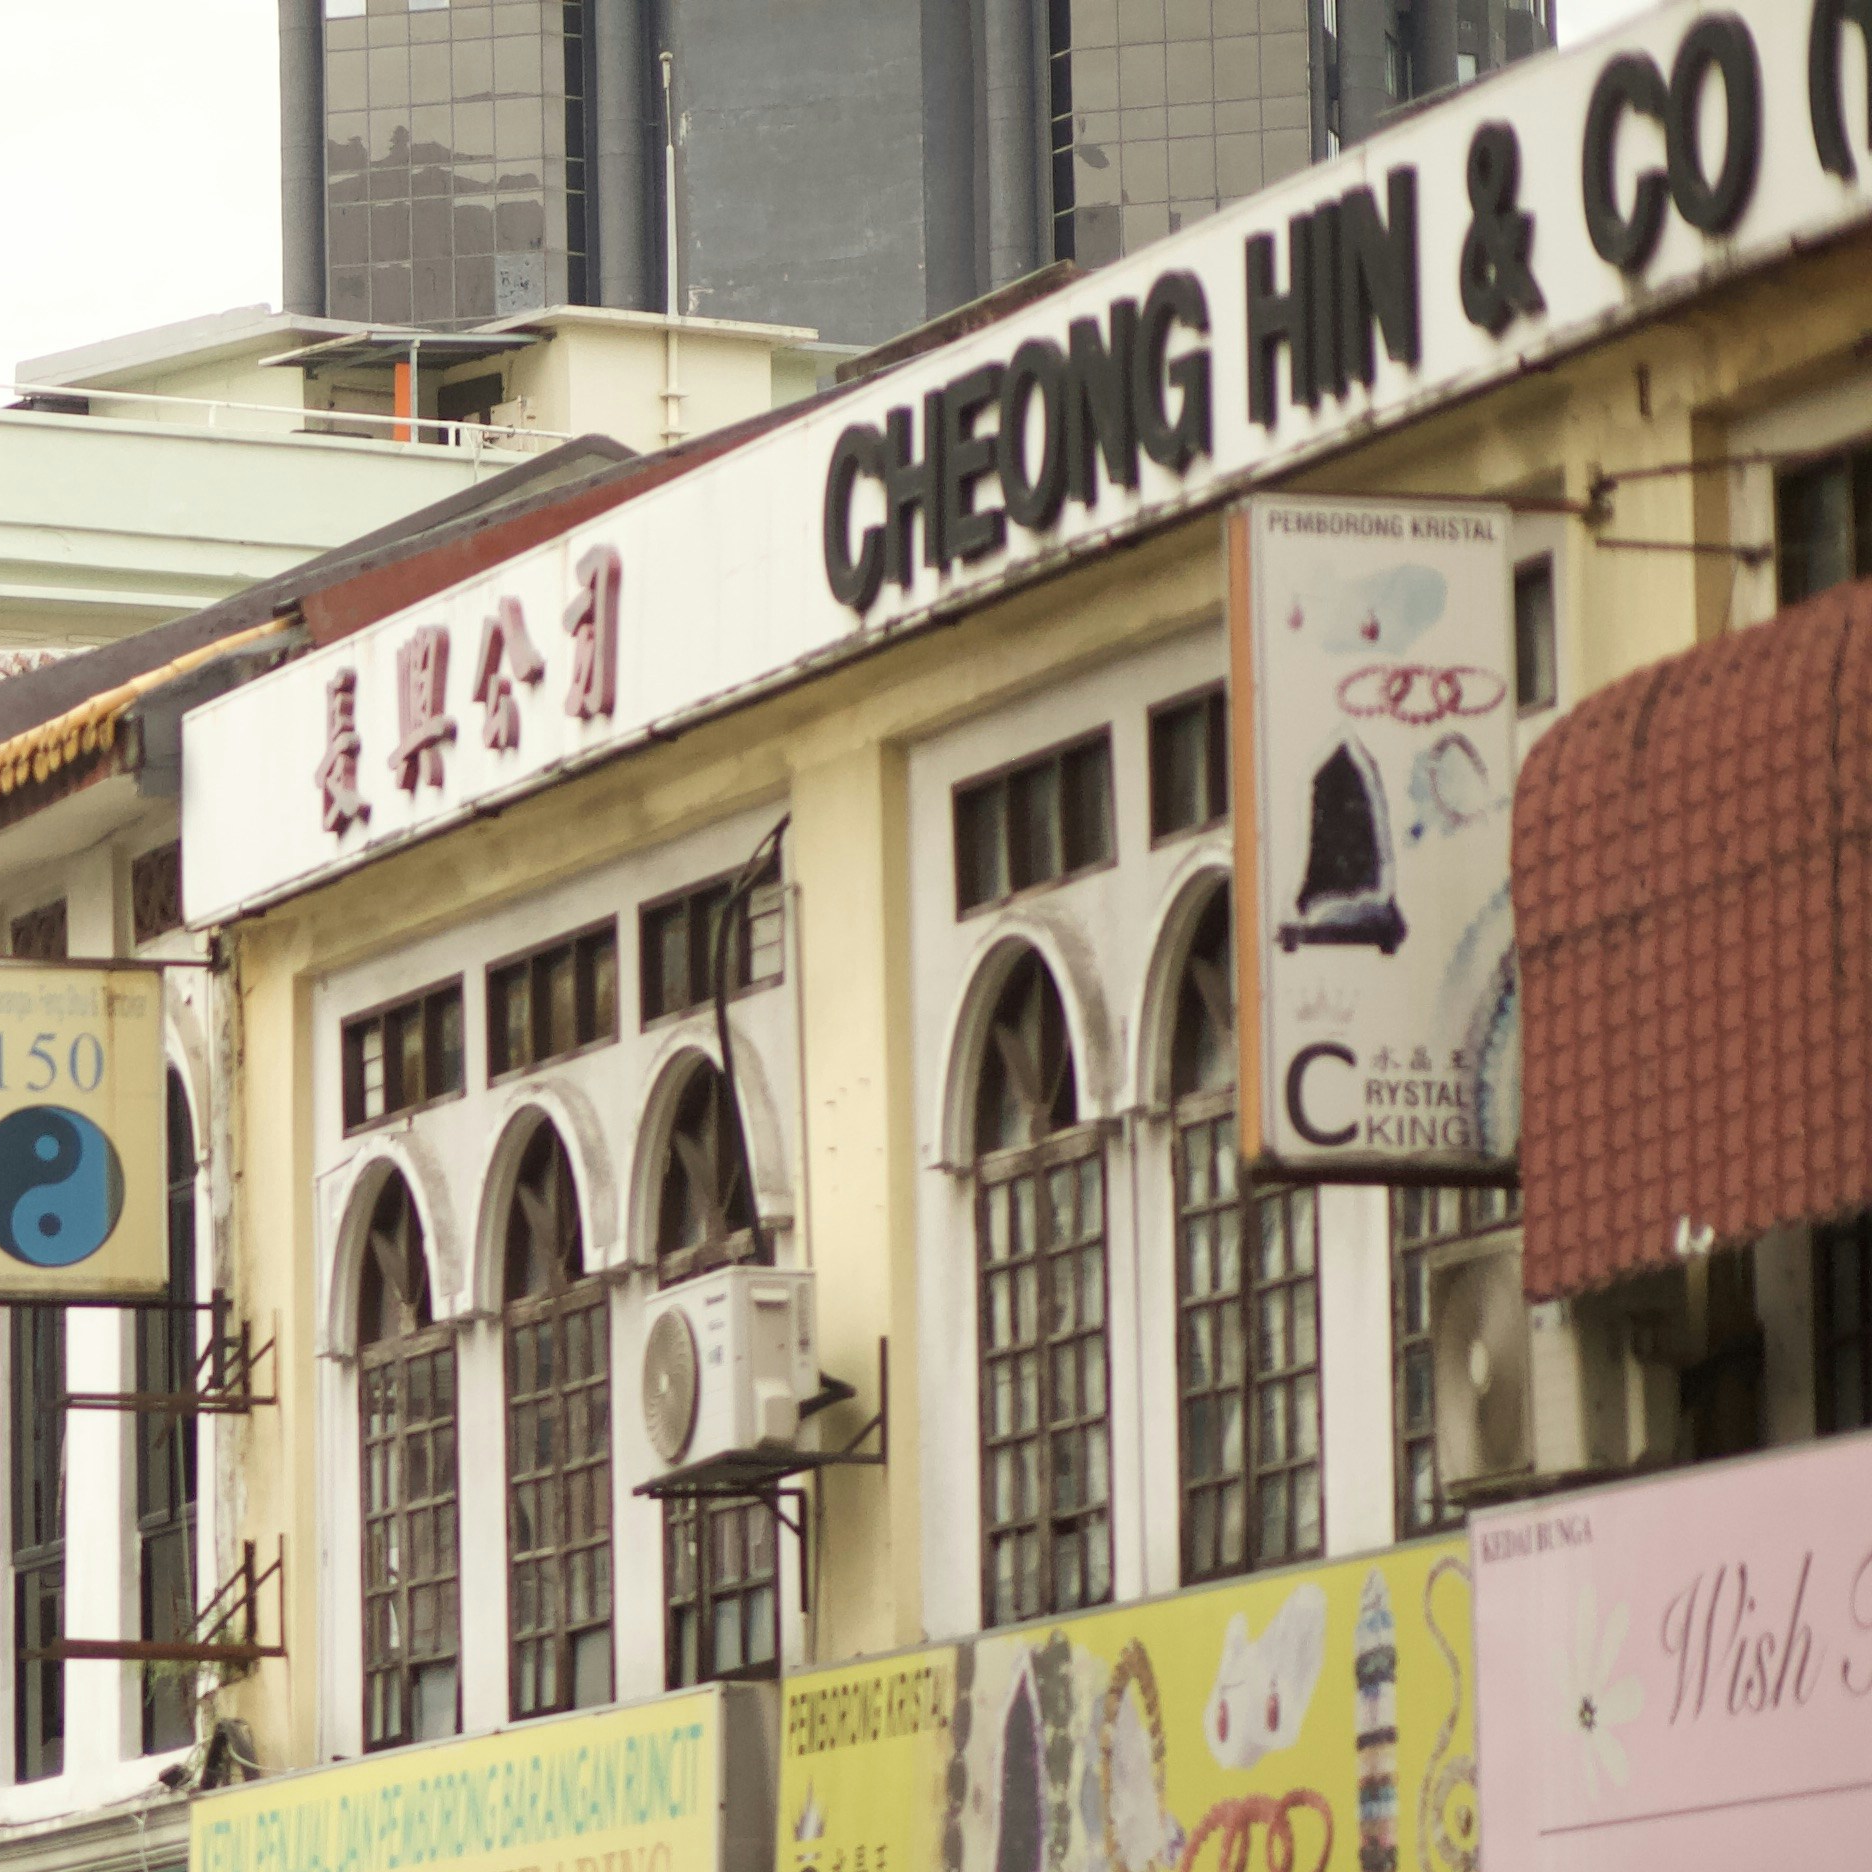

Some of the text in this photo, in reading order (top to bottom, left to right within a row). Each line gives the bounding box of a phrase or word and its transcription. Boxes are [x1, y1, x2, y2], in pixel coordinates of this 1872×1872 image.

[824, 267, 1214, 613] CHEONG
[1244, 164, 1420, 433] HIN
[1460, 119, 1546, 340] &
[1582, 13, 1762, 274] CO
[1268, 512, 1497, 543] PEMBORONG KRISTAL
[1365, 1115, 1471, 1148] KING
[1481, 1513, 1594, 1564] KEDAI BUNGA
[1661, 1550, 1826, 1727] Wish
